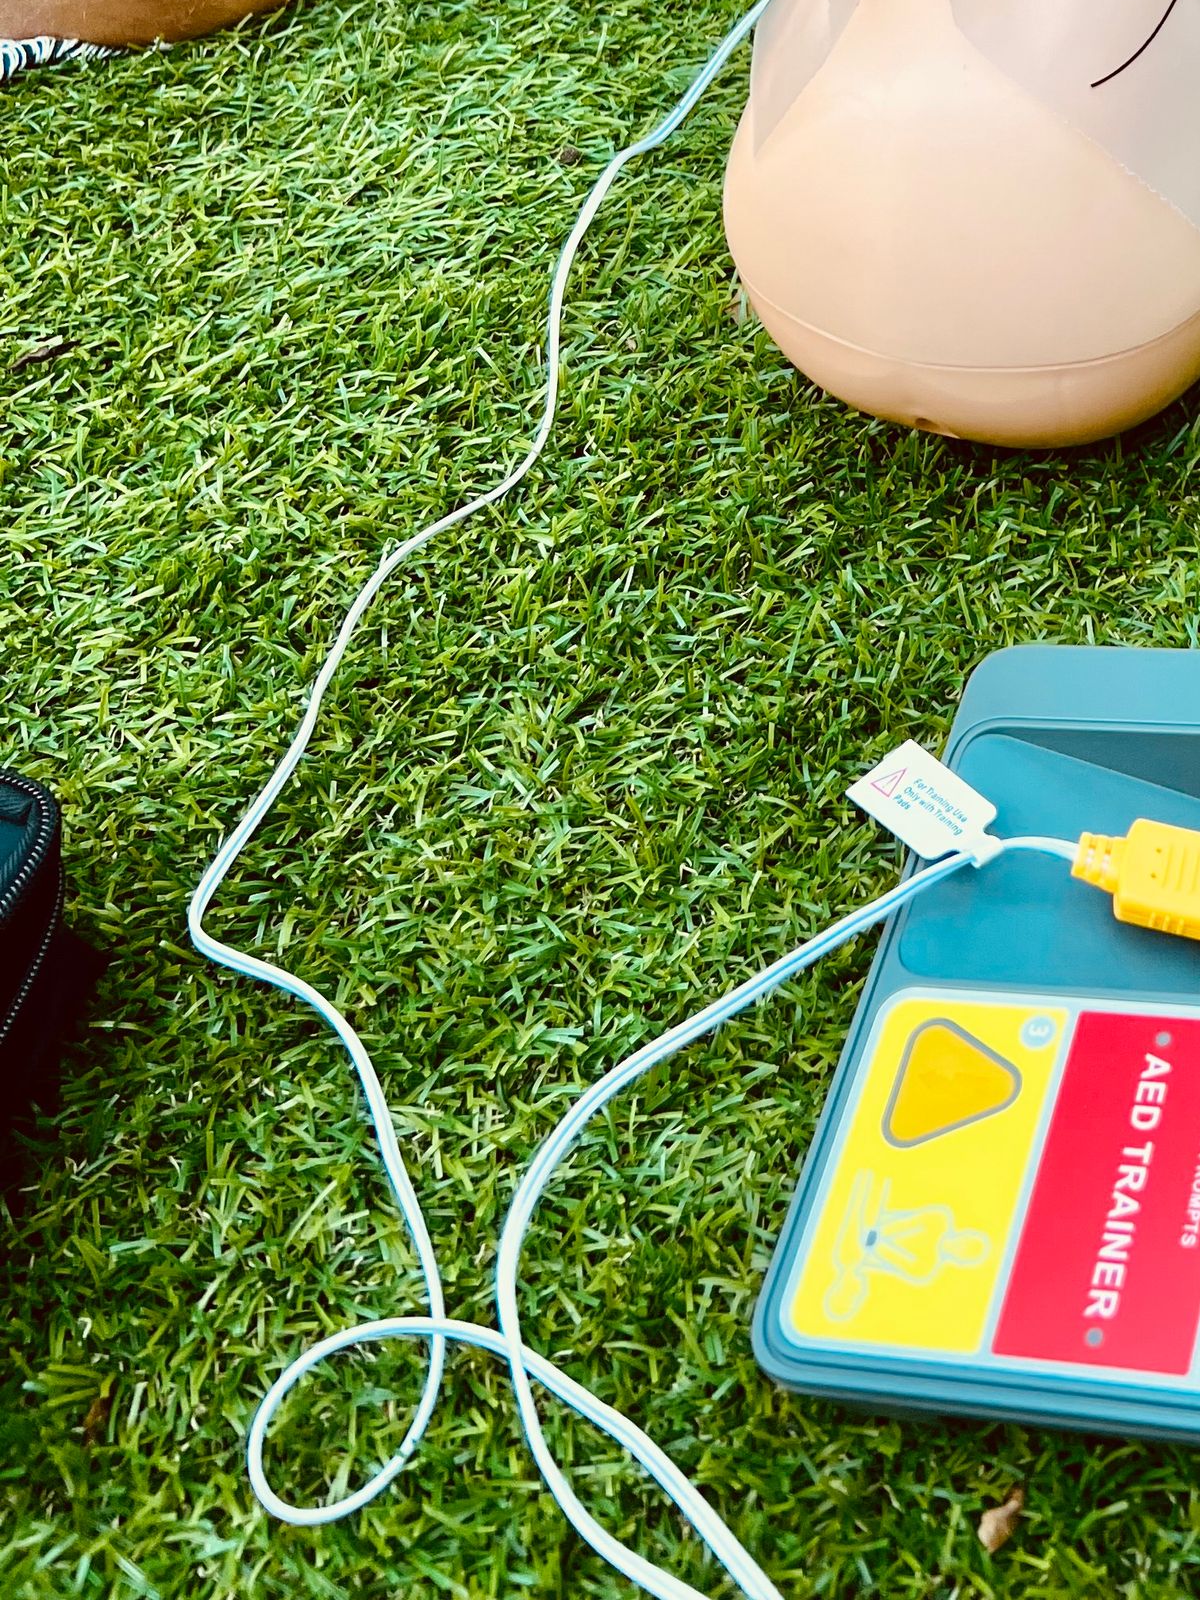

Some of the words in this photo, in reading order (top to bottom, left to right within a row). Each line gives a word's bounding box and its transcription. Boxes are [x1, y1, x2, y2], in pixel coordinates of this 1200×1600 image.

[893, 794, 911, 810] Pads
[903, 786, 920, 803] Only
[919, 797, 935, 813] with
[933, 809, 963, 836] Training
[913, 778, 927, 791] For
[926, 786, 954, 813] Training
[952, 808, 968, 823] Use
[1130, 1052, 1172, 1131] AED
[1083, 1141, 1154, 1319] TRAINER
